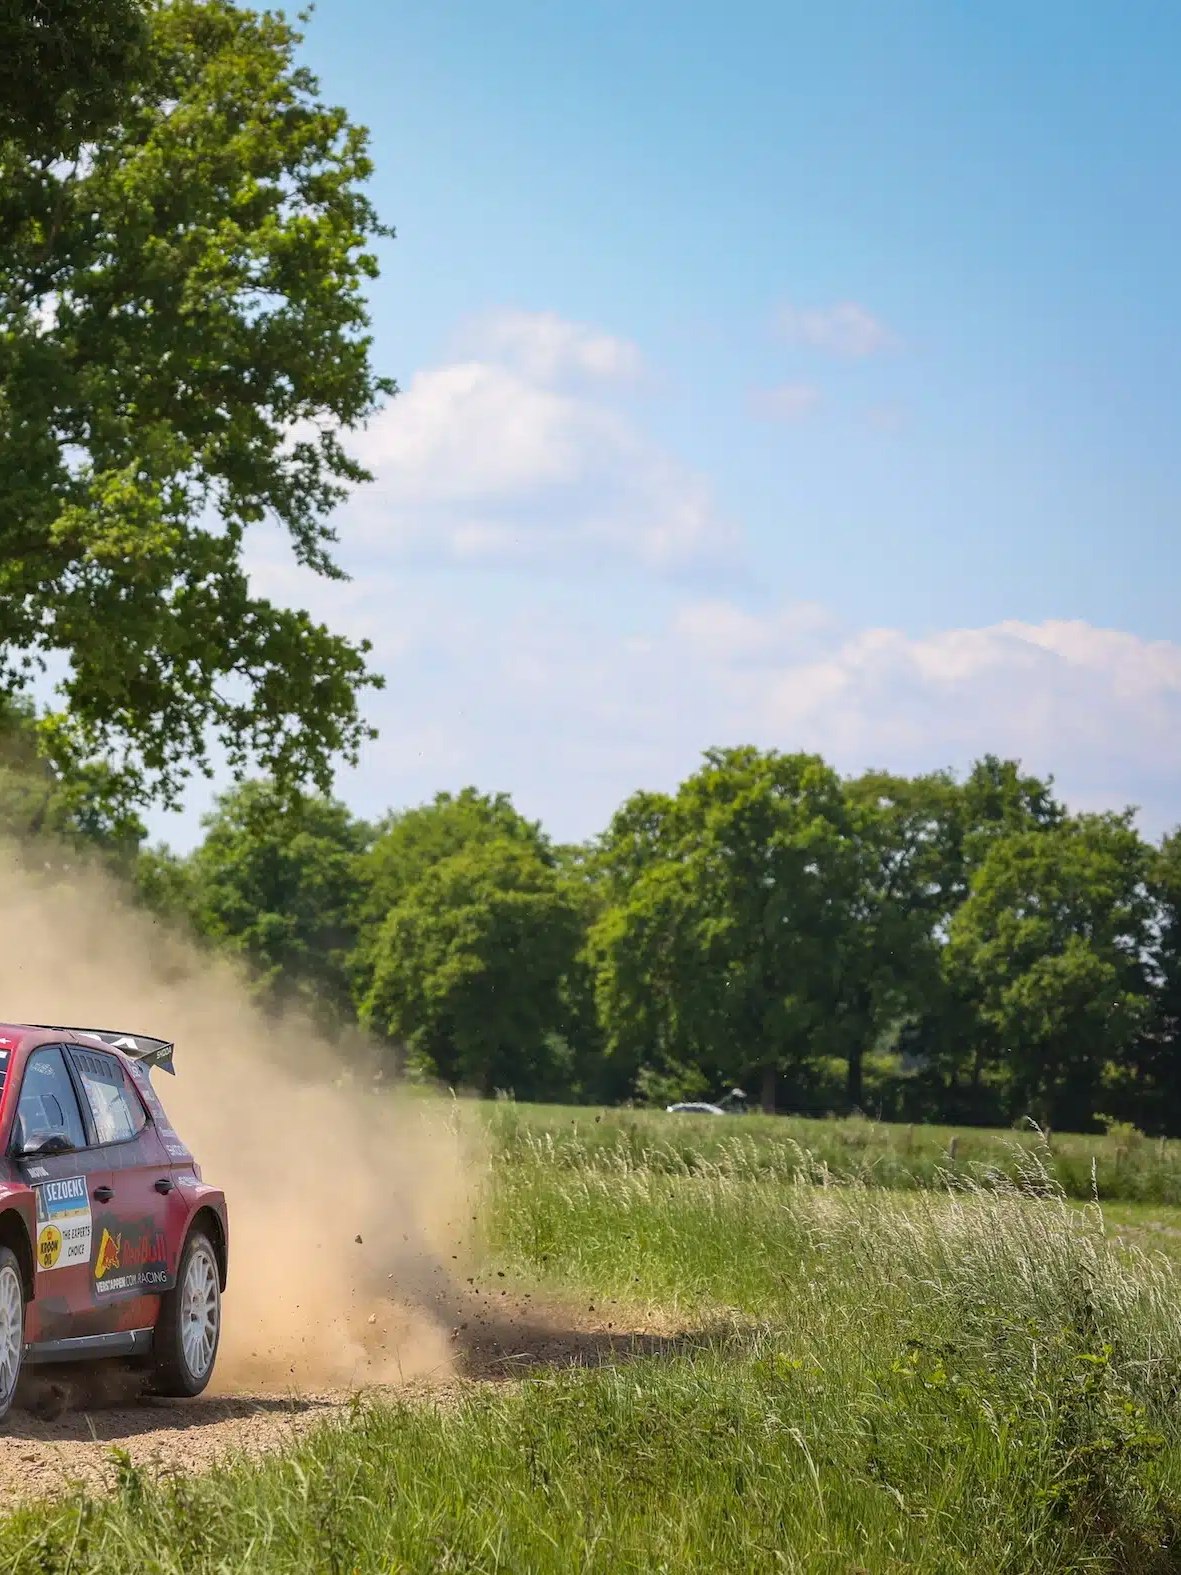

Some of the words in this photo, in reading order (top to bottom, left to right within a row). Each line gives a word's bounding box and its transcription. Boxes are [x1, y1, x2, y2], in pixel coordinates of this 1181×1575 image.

[46, 1179, 84, 1201] SEZOENS
[71, 1226, 90, 1239] EXPERTS
[40, 1240, 58, 1254] KROON
[67, 1244, 85, 1257] CHOICE
[44, 1254, 52, 1266] OIL
[138, 1270, 167, 1284] RACING
